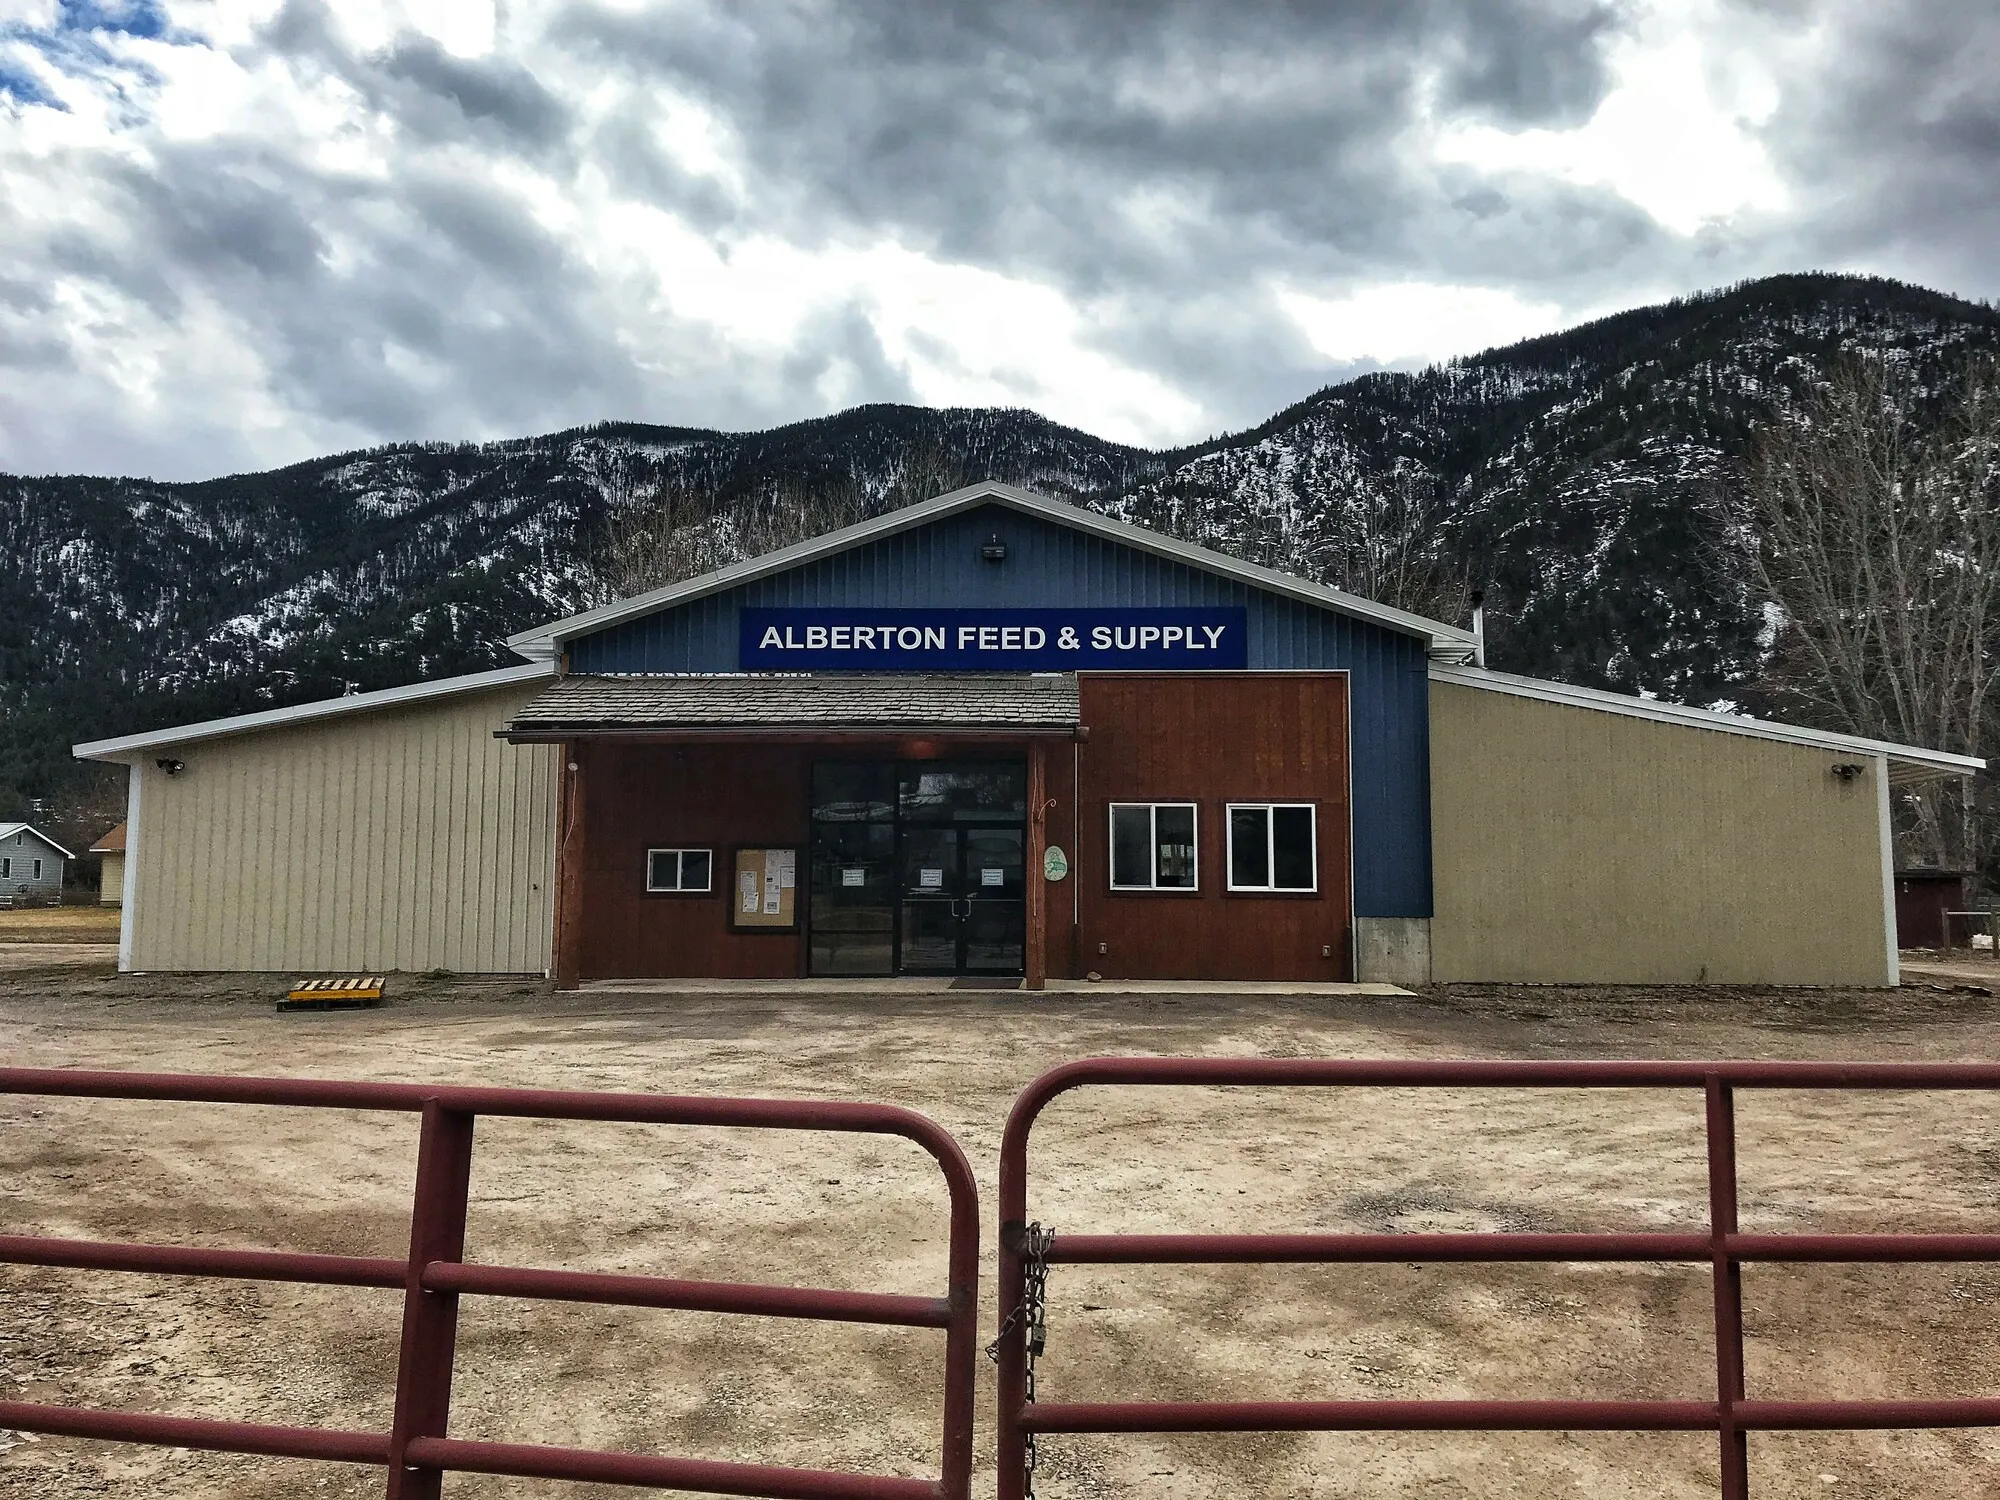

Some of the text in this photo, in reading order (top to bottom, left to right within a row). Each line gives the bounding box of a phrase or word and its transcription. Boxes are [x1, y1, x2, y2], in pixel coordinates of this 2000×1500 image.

[758, 625, 1226, 650] ALBERTON FEED & SUPPLY
